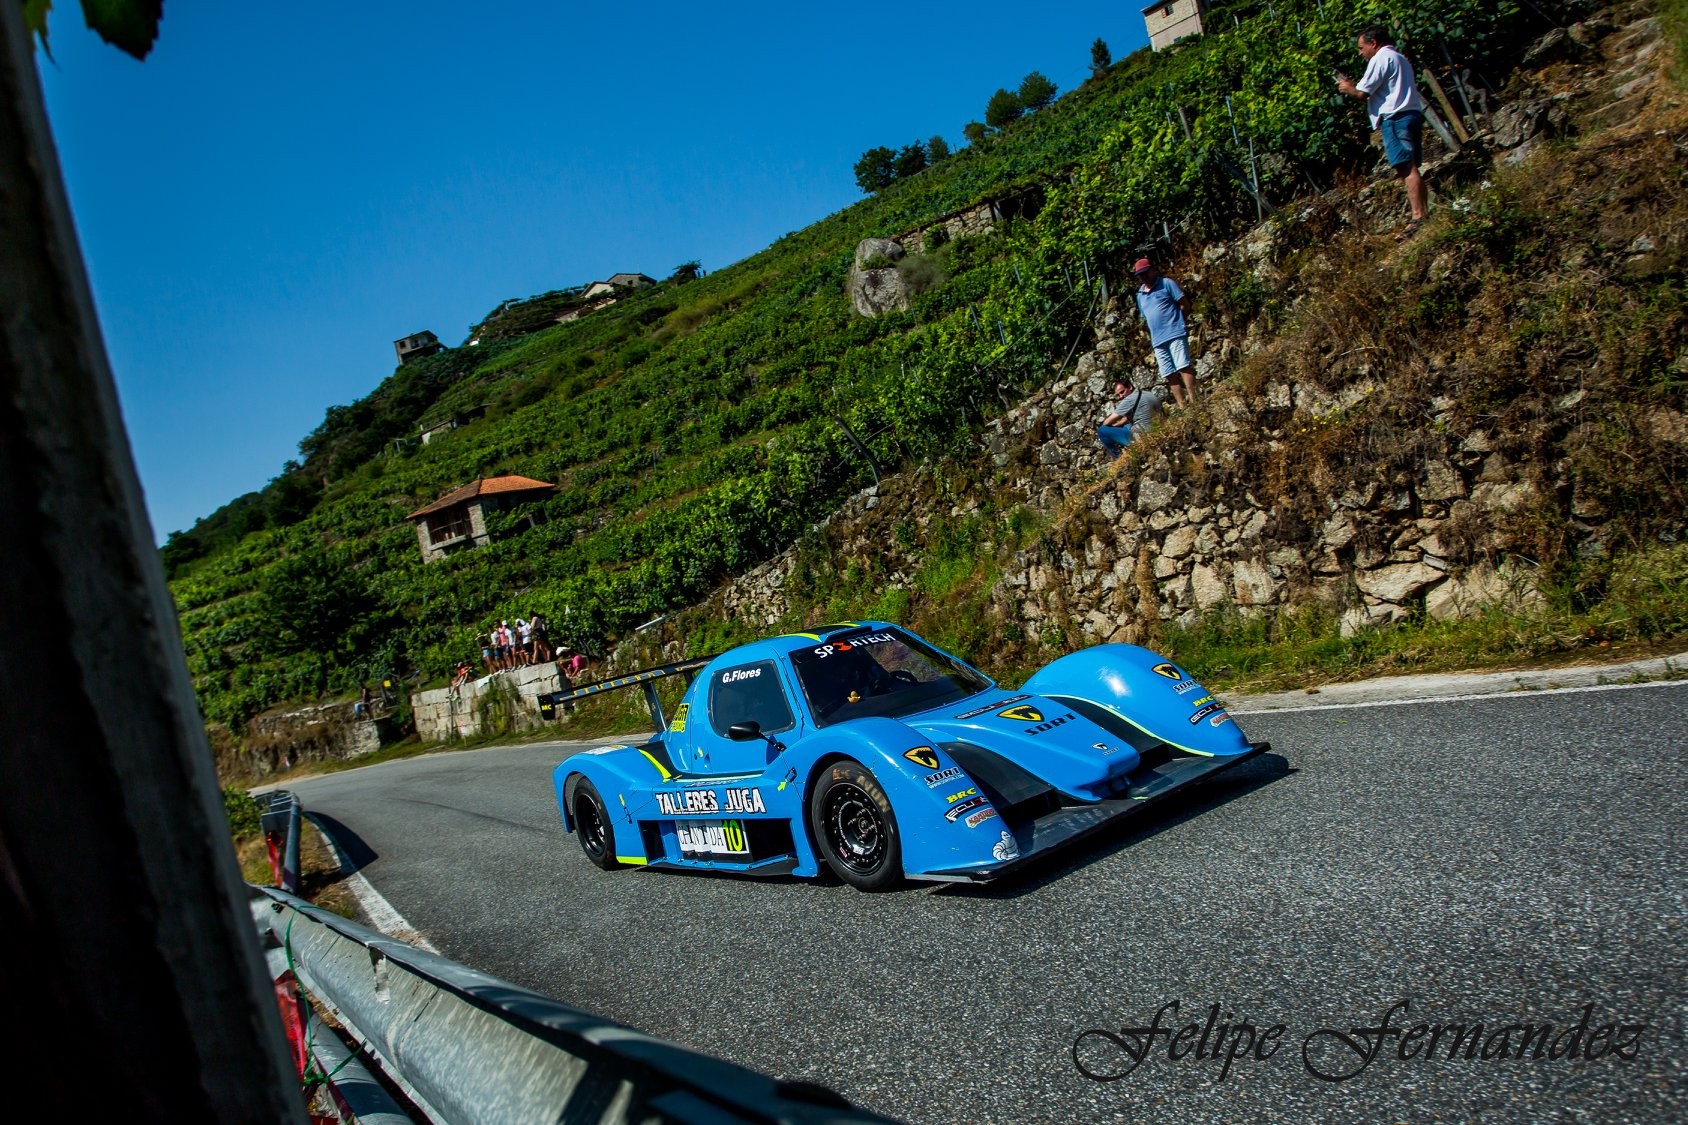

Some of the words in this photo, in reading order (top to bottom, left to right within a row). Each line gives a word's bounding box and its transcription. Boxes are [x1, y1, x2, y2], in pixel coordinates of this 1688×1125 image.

[722, 667, 761, 684] G.Flores
[656, 789, 720, 815] TALLERES
[724, 786, 767, 814] JUGA
[946, 788, 976, 804] BRC
[722, 819, 743, 852] 10
